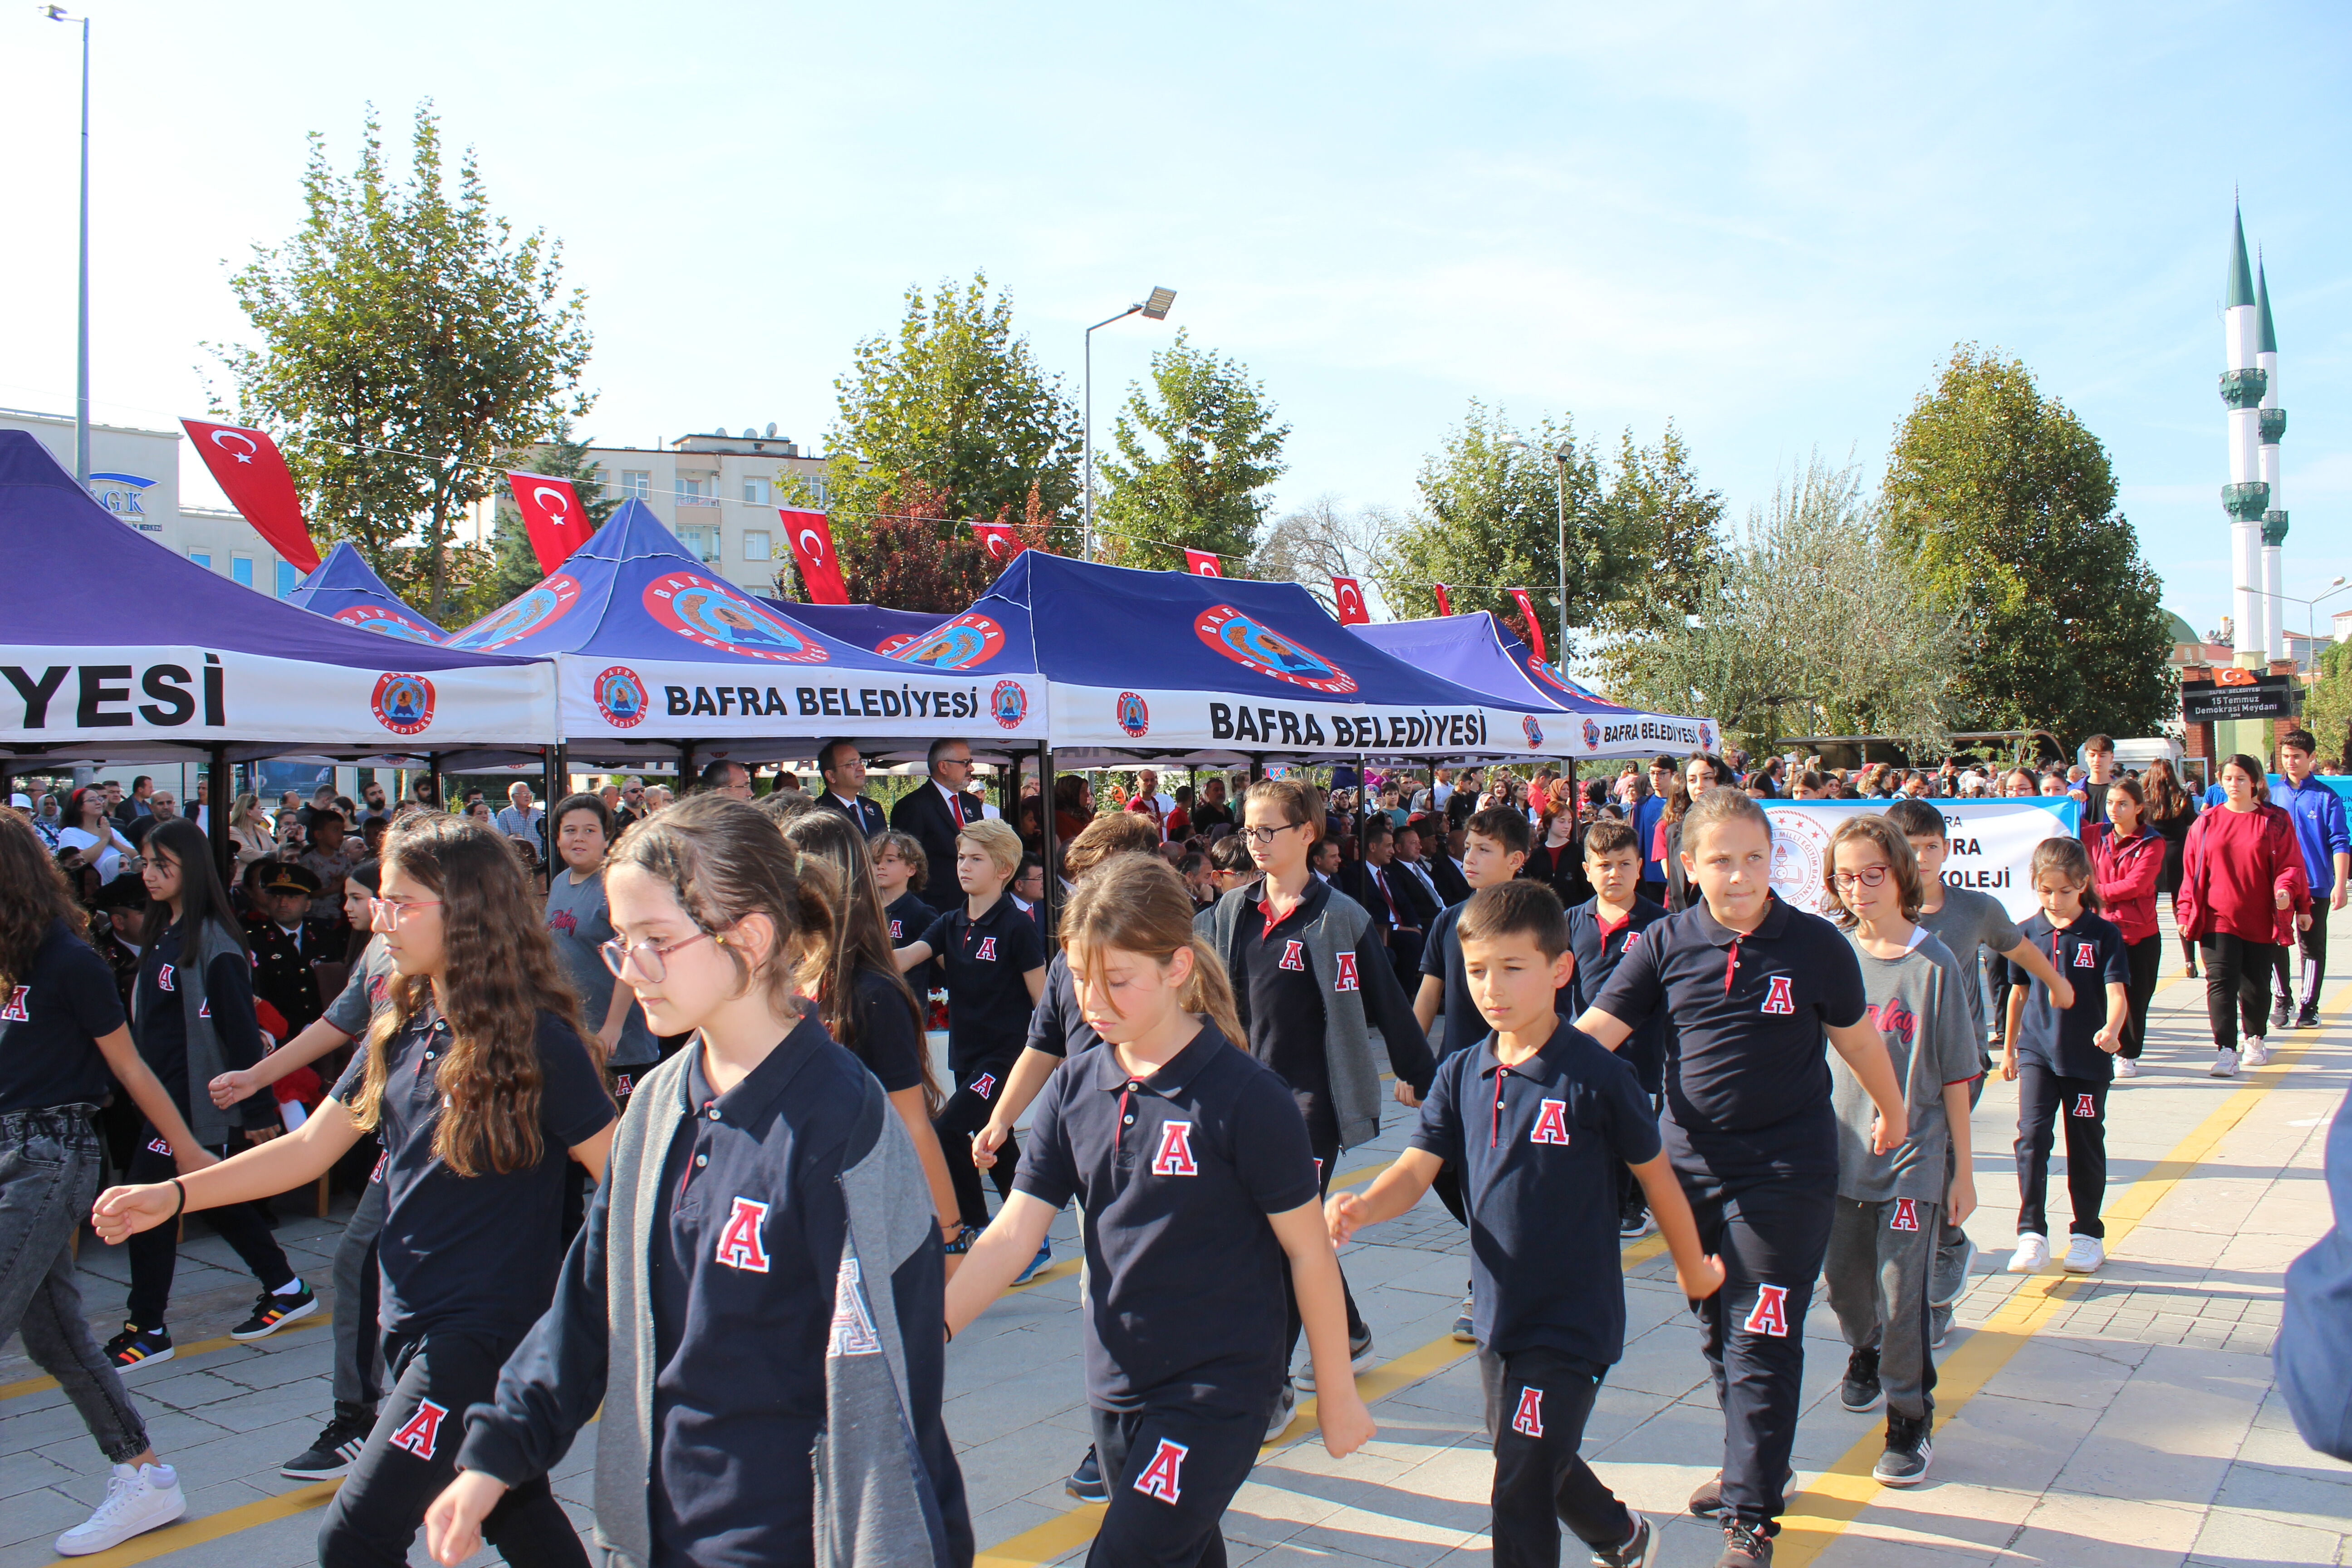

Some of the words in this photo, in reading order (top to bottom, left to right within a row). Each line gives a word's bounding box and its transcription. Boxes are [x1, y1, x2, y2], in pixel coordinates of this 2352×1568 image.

[653, 576, 751, 608] BAFRA
[340, 609, 430, 637] BAFRA
[677, 628, 828, 663] BELEDİYESİ
[600, 668, 637, 682] BAFRA
[597, 702, 647, 727] BELEDİYESİ
[665, 686, 788, 715] BAFRA
[796, 683, 978, 718] BELEDİYESİ
[2195, 705, 2240, 715] Demokrasi
[2242, 703, 2277, 713] Meydanı
[372, 706, 433, 734] BELEDİYESİ
[1210, 703, 1325, 745] BAFRA
[1331, 708, 1486, 748] BELEDİYESİ
[1604, 724, 1639, 743] BAFRA
[1641, 722, 1698, 744] BELEDİYESİ
[889, 920, 902, 938] A
[976, 936, 996, 961] A
[1279, 939, 1304, 971] A
[2073, 943, 2094, 968] A
[159, 963, 175, 991] A
[1334, 951, 1360, 992] A
[1, 985, 31, 1022] A
[1761, 975, 1795, 1014] A
[616, 1074, 634, 1097] A
[970, 1072, 996, 1100] A
[2073, 1093, 2095, 1117] A
[1530, 1098, 1569, 1146] A
[1152, 1121, 1198, 1176] A
[1889, 1196, 1919, 1232] A
[715, 1196, 770, 1273] A
[1743, 1283, 1788, 1337] A
[1512, 1385, 1544, 1438] A
[389, 1397, 449, 1461] A
[1133, 1438, 1189, 1505] A
